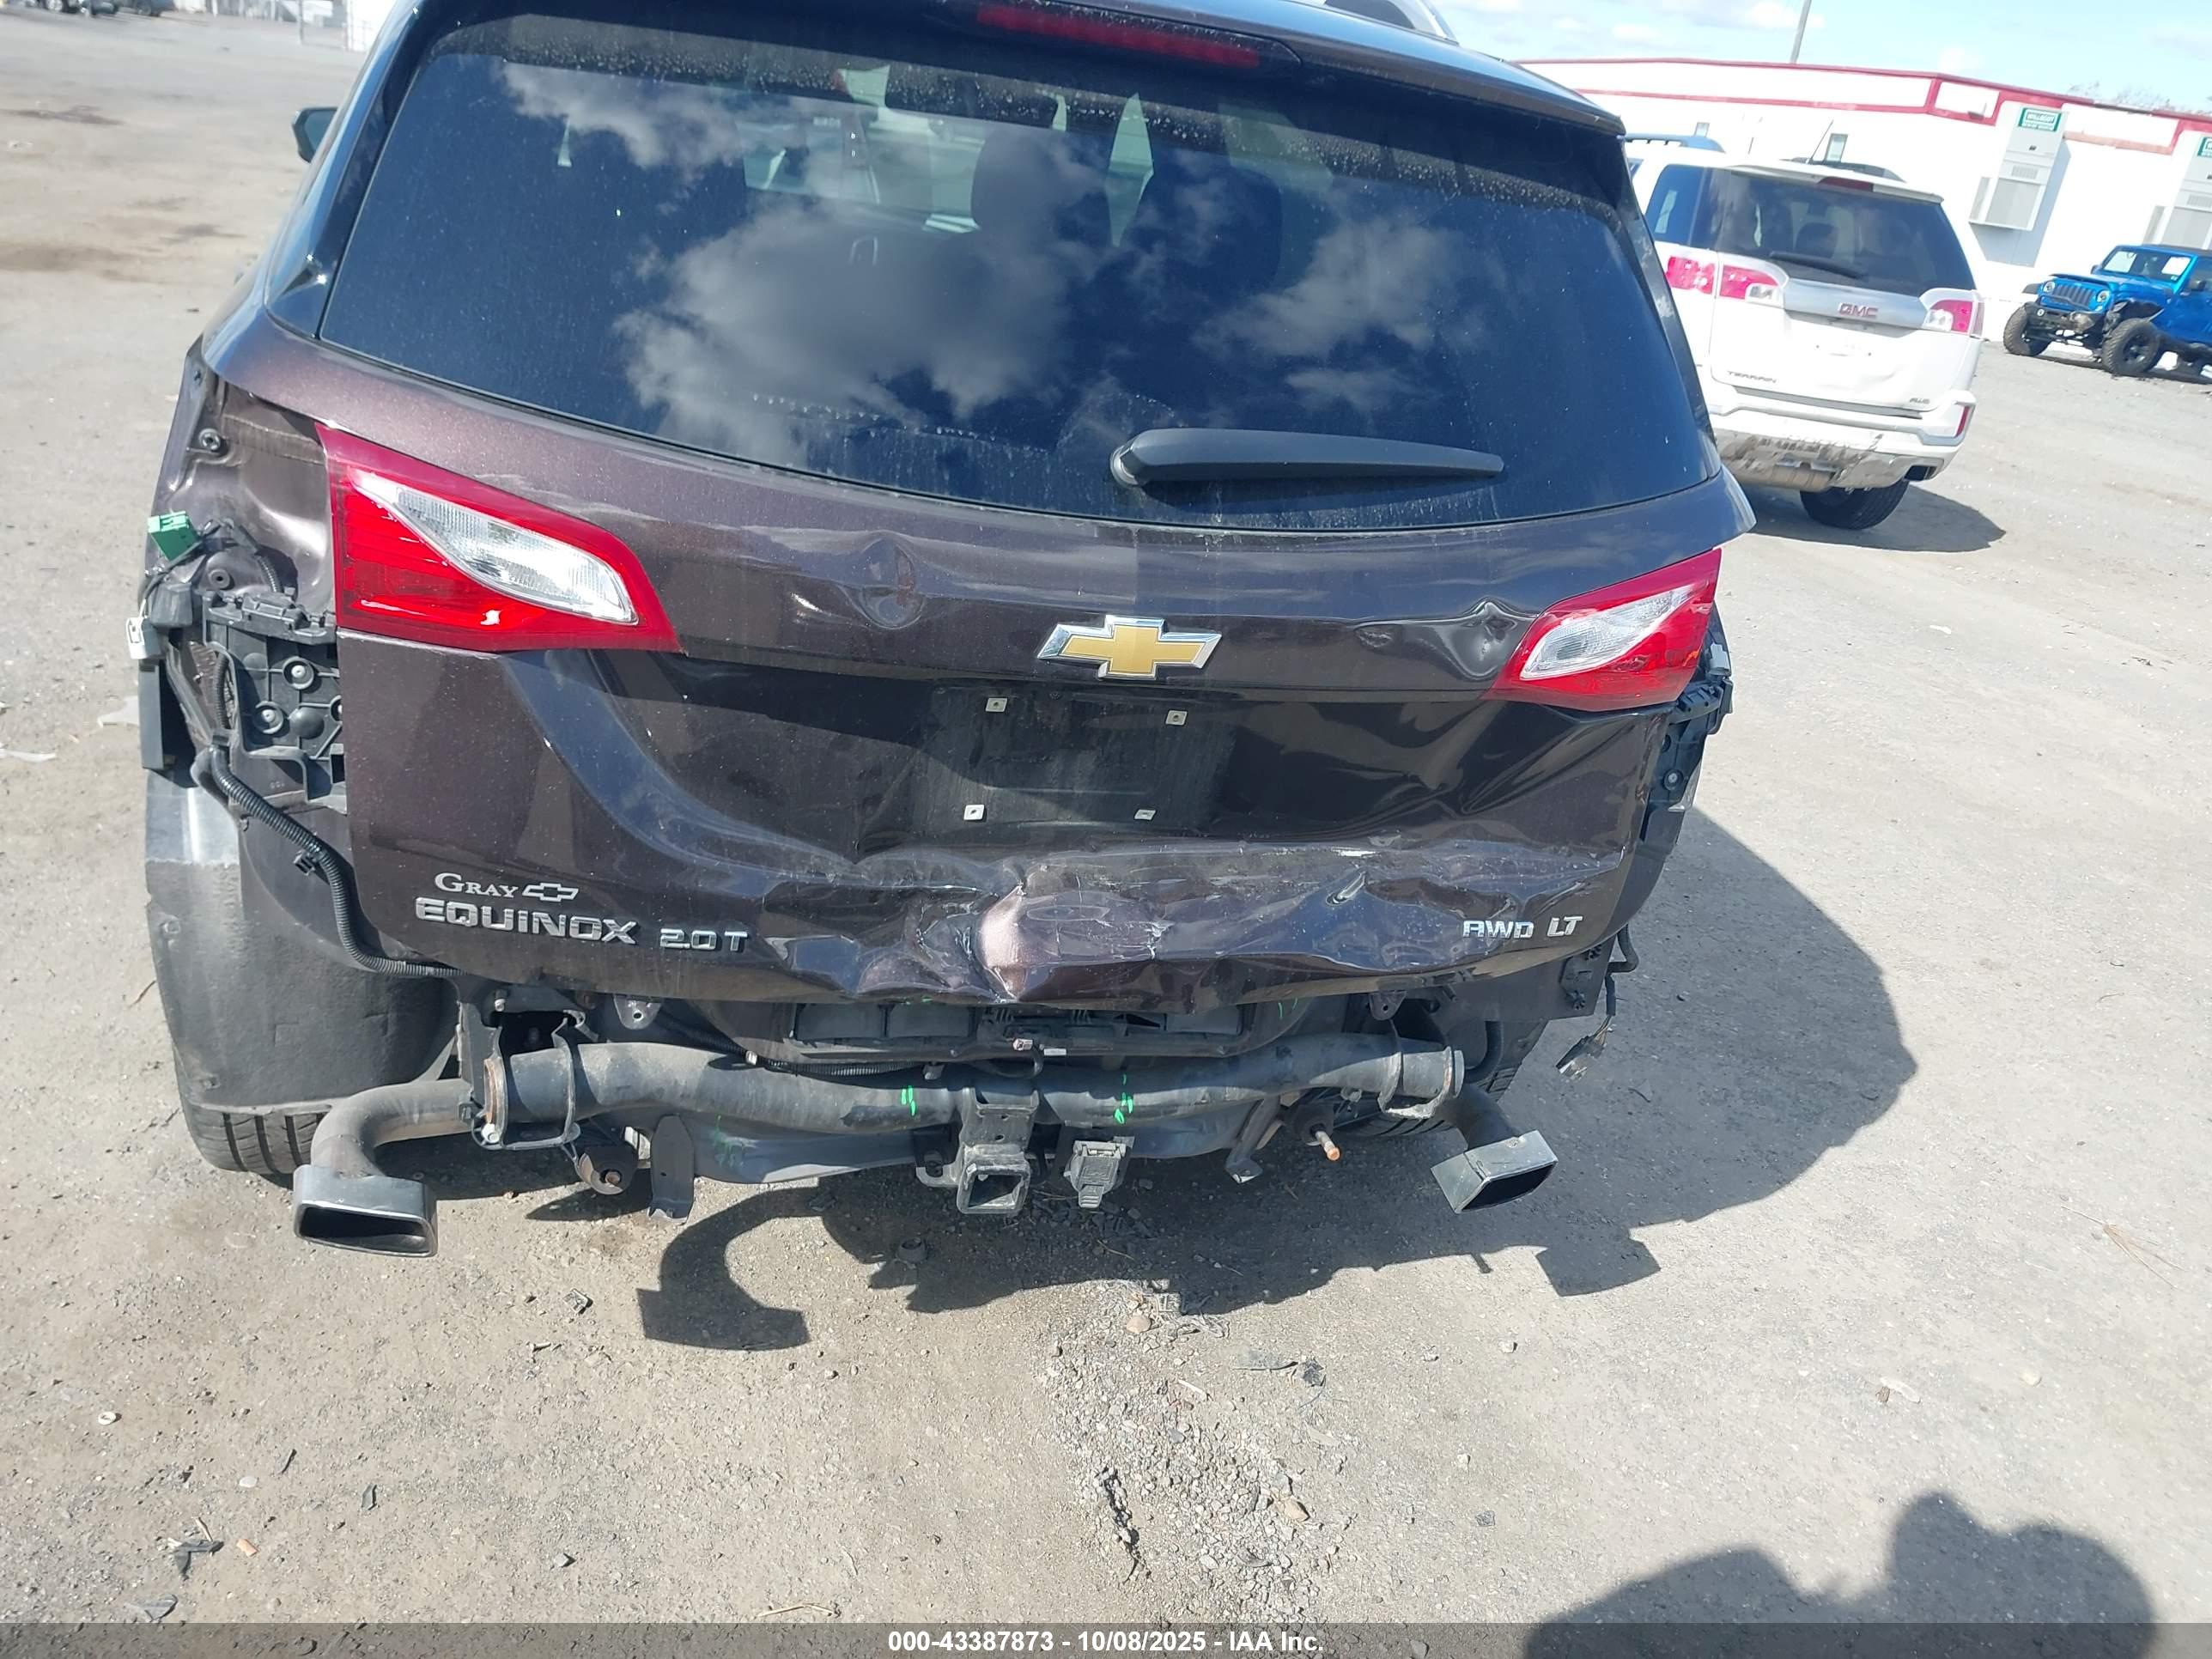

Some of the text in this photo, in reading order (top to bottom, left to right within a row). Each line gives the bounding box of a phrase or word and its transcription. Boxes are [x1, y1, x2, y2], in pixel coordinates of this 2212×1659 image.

[1838, 303, 1878, 318] GMC
[416, 896, 637, 945] EQUINOX
[1462, 915, 1583, 939] AWD LT
